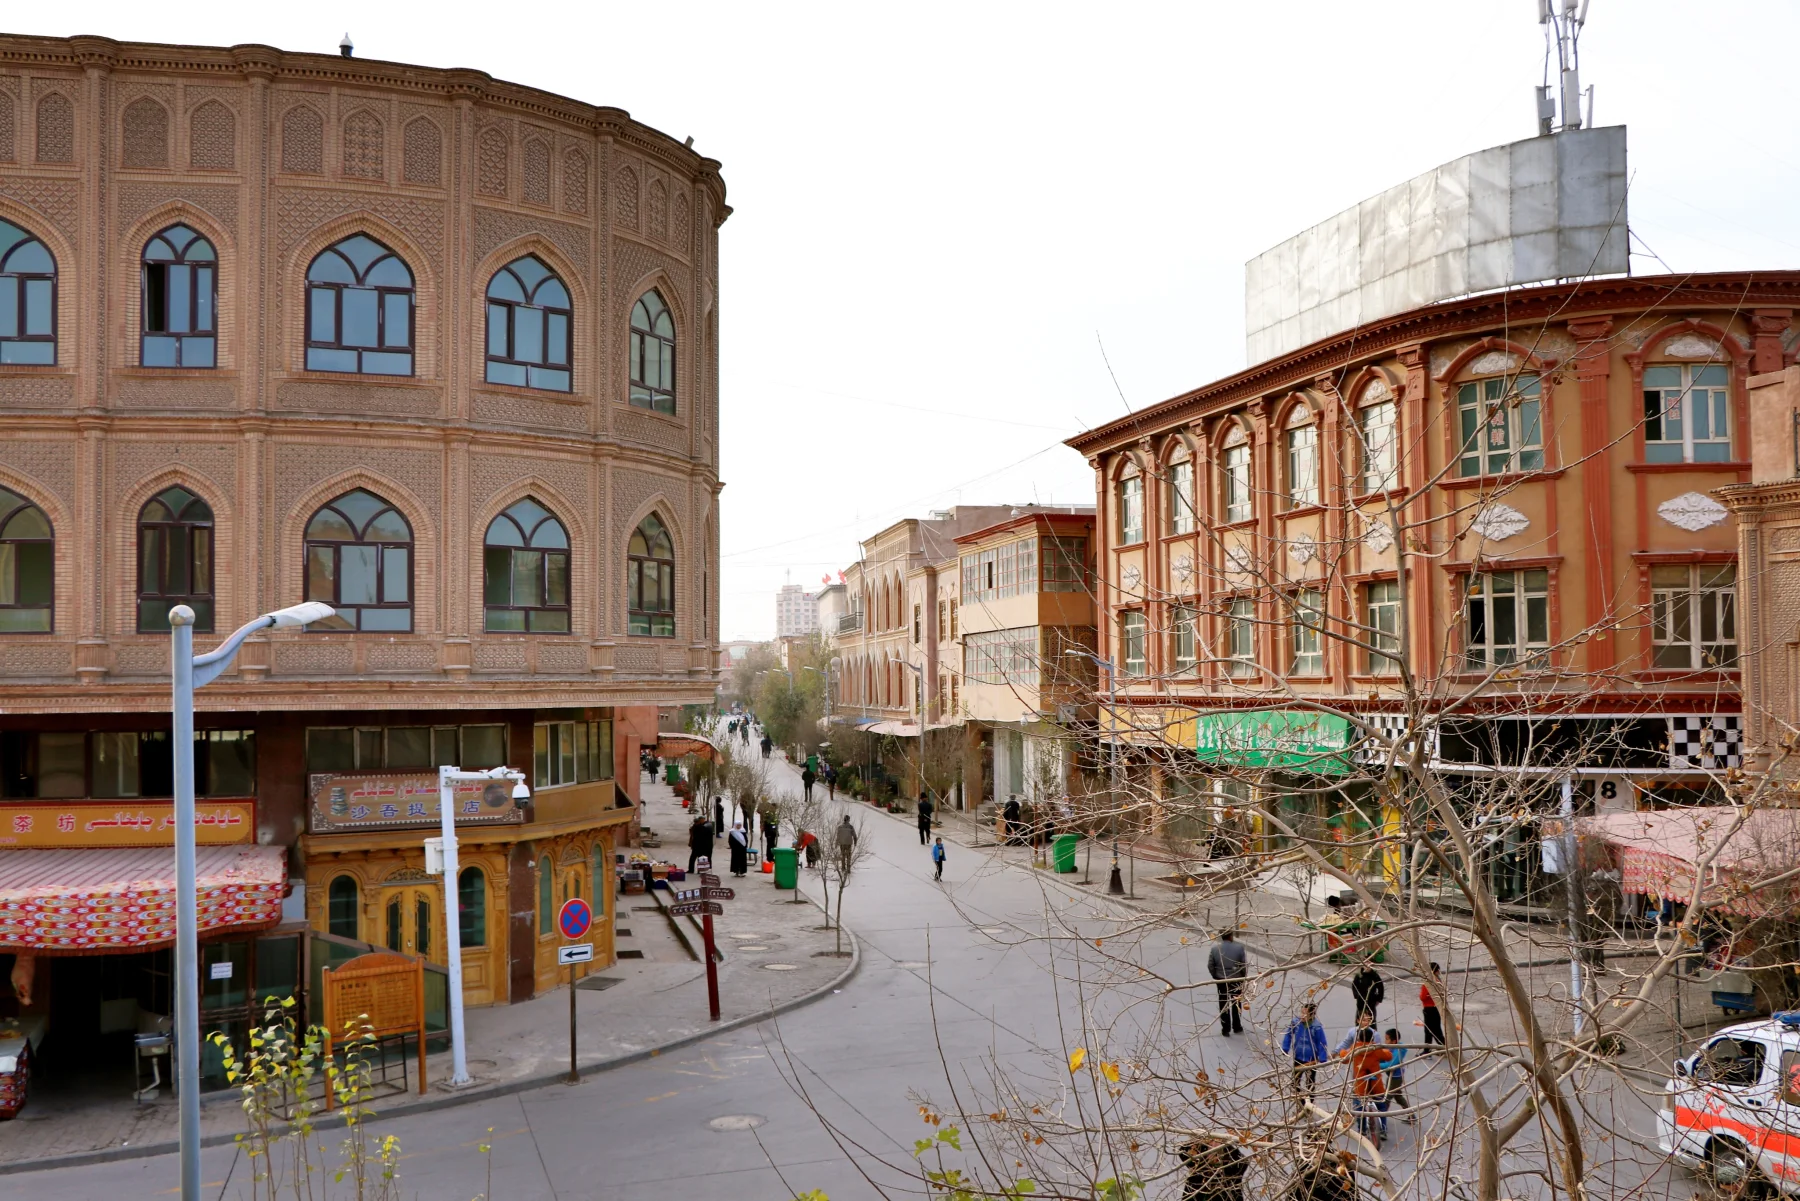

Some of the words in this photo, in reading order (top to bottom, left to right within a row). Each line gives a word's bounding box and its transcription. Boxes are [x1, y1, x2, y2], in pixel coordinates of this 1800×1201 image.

[1601, 781, 1617, 799] 8
[351, 800, 481, 819] 沙吾提店
